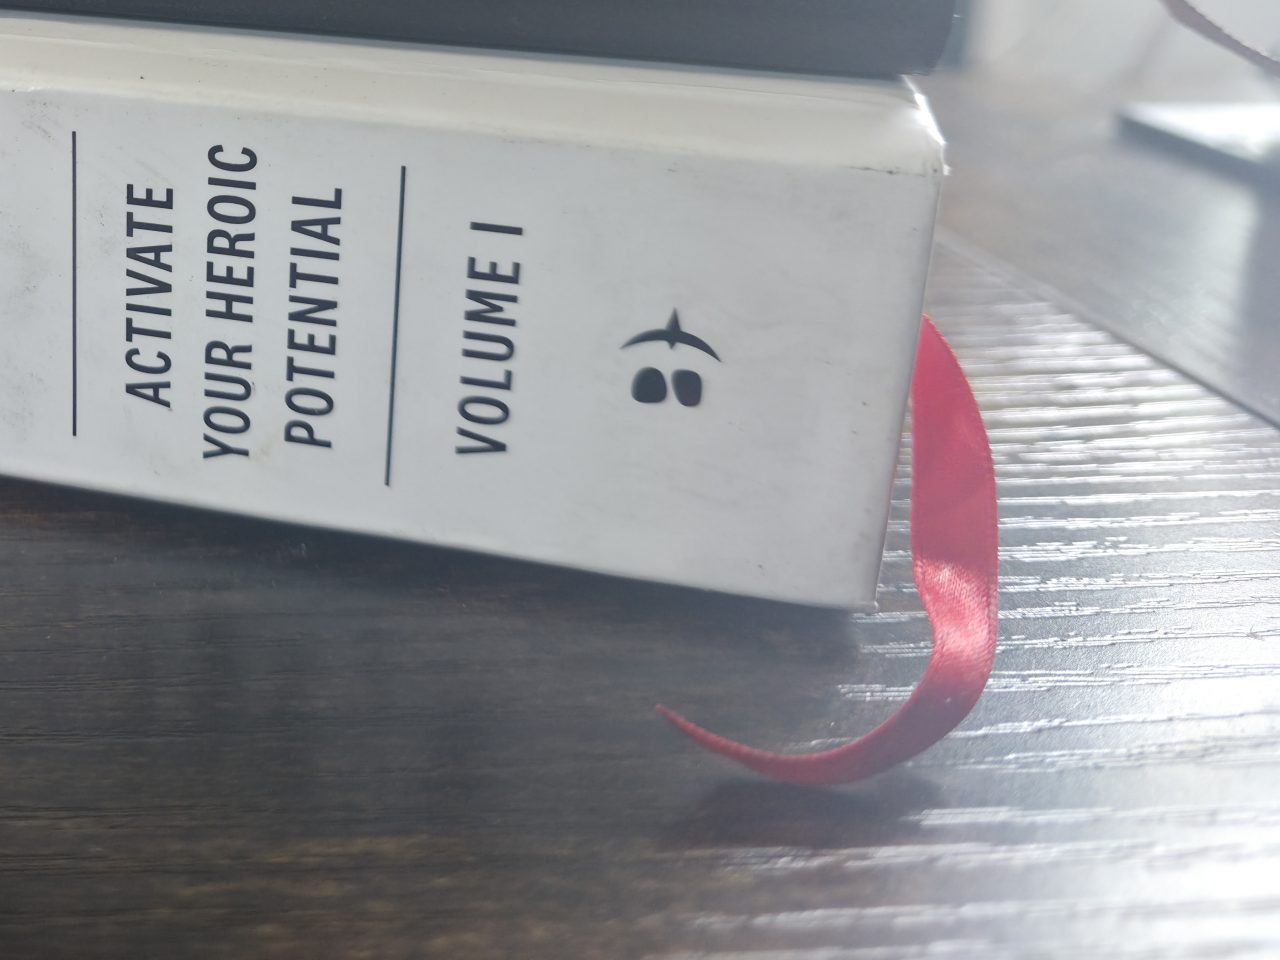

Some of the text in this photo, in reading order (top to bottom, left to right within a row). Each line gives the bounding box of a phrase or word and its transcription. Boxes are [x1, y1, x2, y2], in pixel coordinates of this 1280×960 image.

[125, 183, 174, 409] ACTIVATE
[203, 144, 258, 459] YOUR HEROIC
[284, 187, 342, 449] POTENTIAL
[455, 221, 524, 455] VOLUME I
